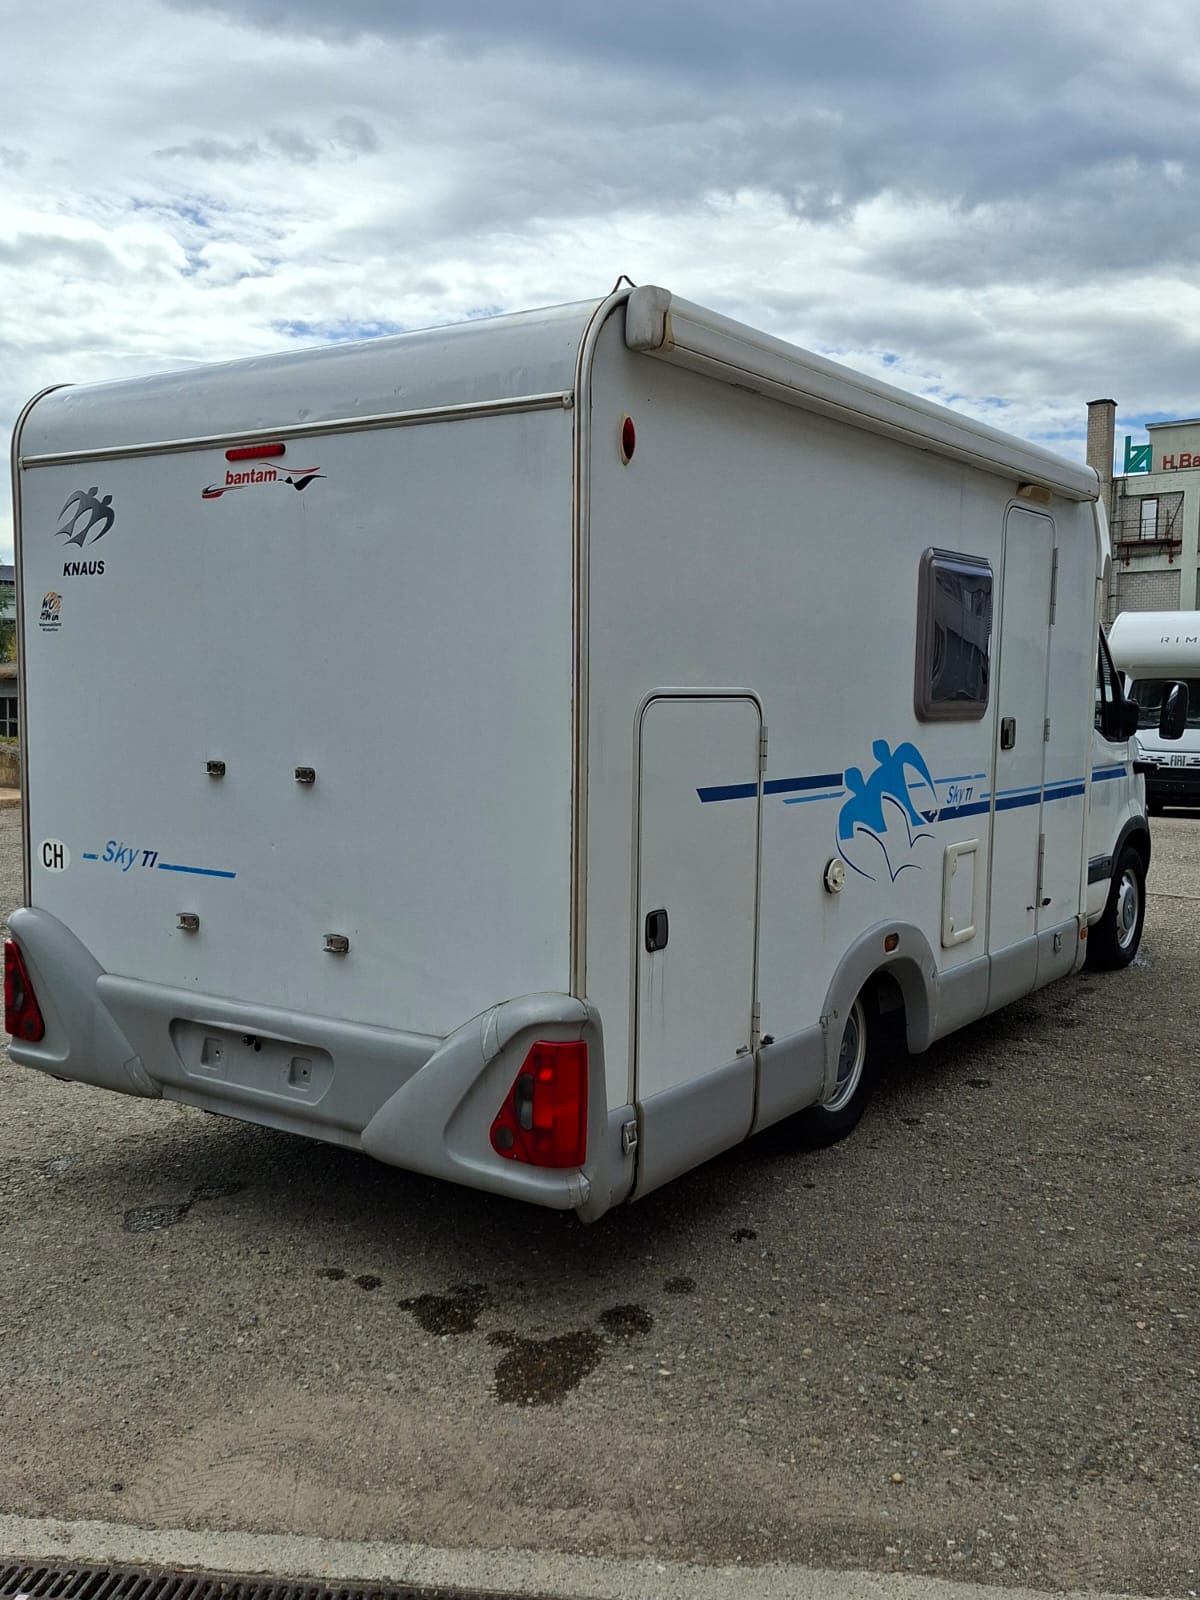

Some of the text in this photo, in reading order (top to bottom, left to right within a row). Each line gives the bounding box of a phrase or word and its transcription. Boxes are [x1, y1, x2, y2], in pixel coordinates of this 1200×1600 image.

[225, 468, 277, 485] bantam
[63, 560, 105, 576] KNAUS
[1170, 754, 1187, 767] FIAT
[946, 784, 964, 809] Sky
[43, 842, 64, 869] CH
[102, 840, 158, 872] Sky TI
